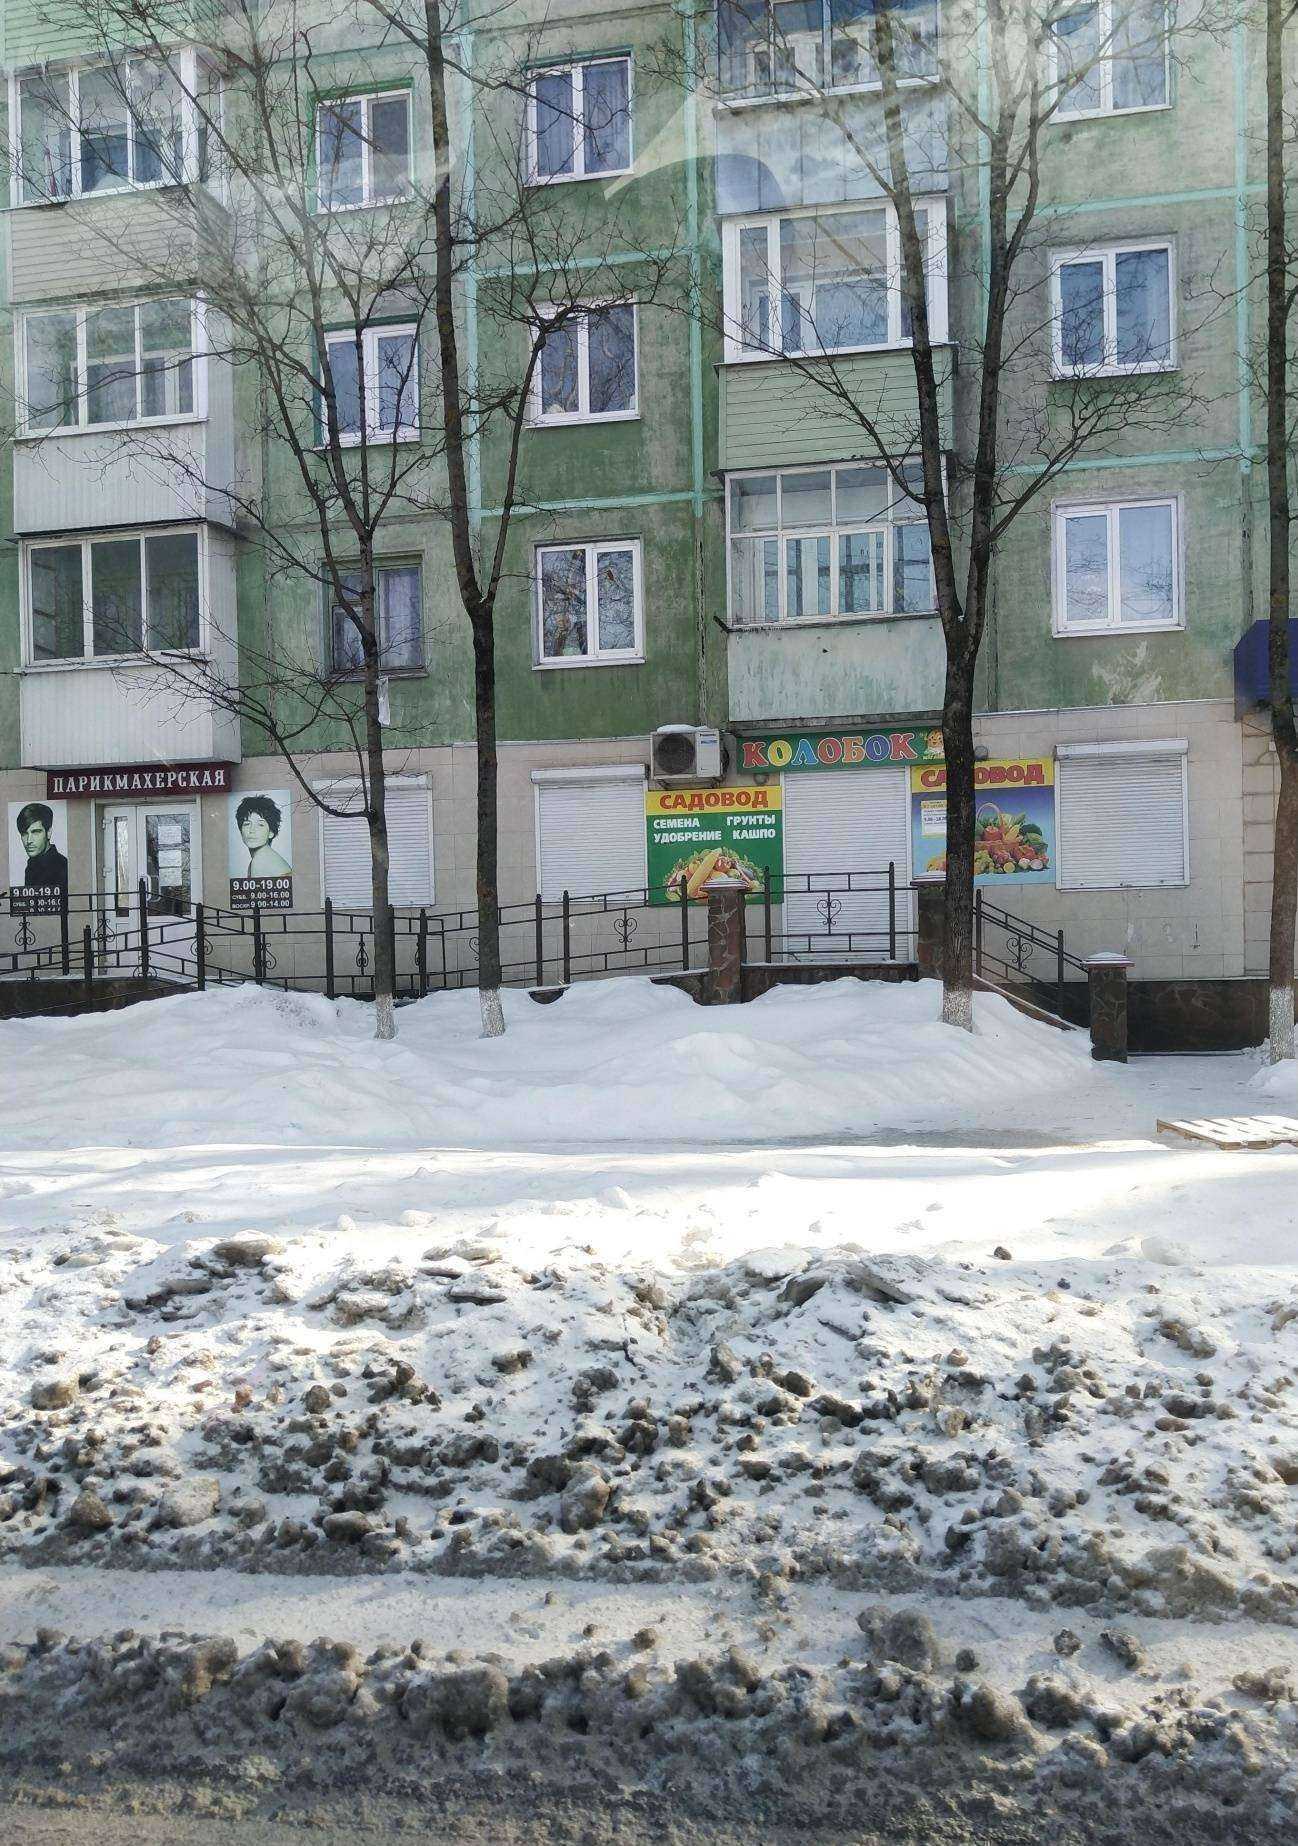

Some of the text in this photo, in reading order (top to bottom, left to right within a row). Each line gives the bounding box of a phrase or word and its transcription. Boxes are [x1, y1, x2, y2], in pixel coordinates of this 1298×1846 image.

[742, 732, 918, 769] КОЛОБОК
[52, 769, 227, 793] ПАРИКМАХЕРСКАЯ
[920, 764, 1045, 788] САОВОД
[659, 790, 769, 811] САДОВОД
[653, 814, 776, 829] СЕМЕНА ГРУНТЫ
[653, 828, 776, 844] УДОБРЕНИЕ КАШПО
[12, 886, 60, 897] 9.00-19.0
[232, 879, 290, 890] 9.00-19.00
